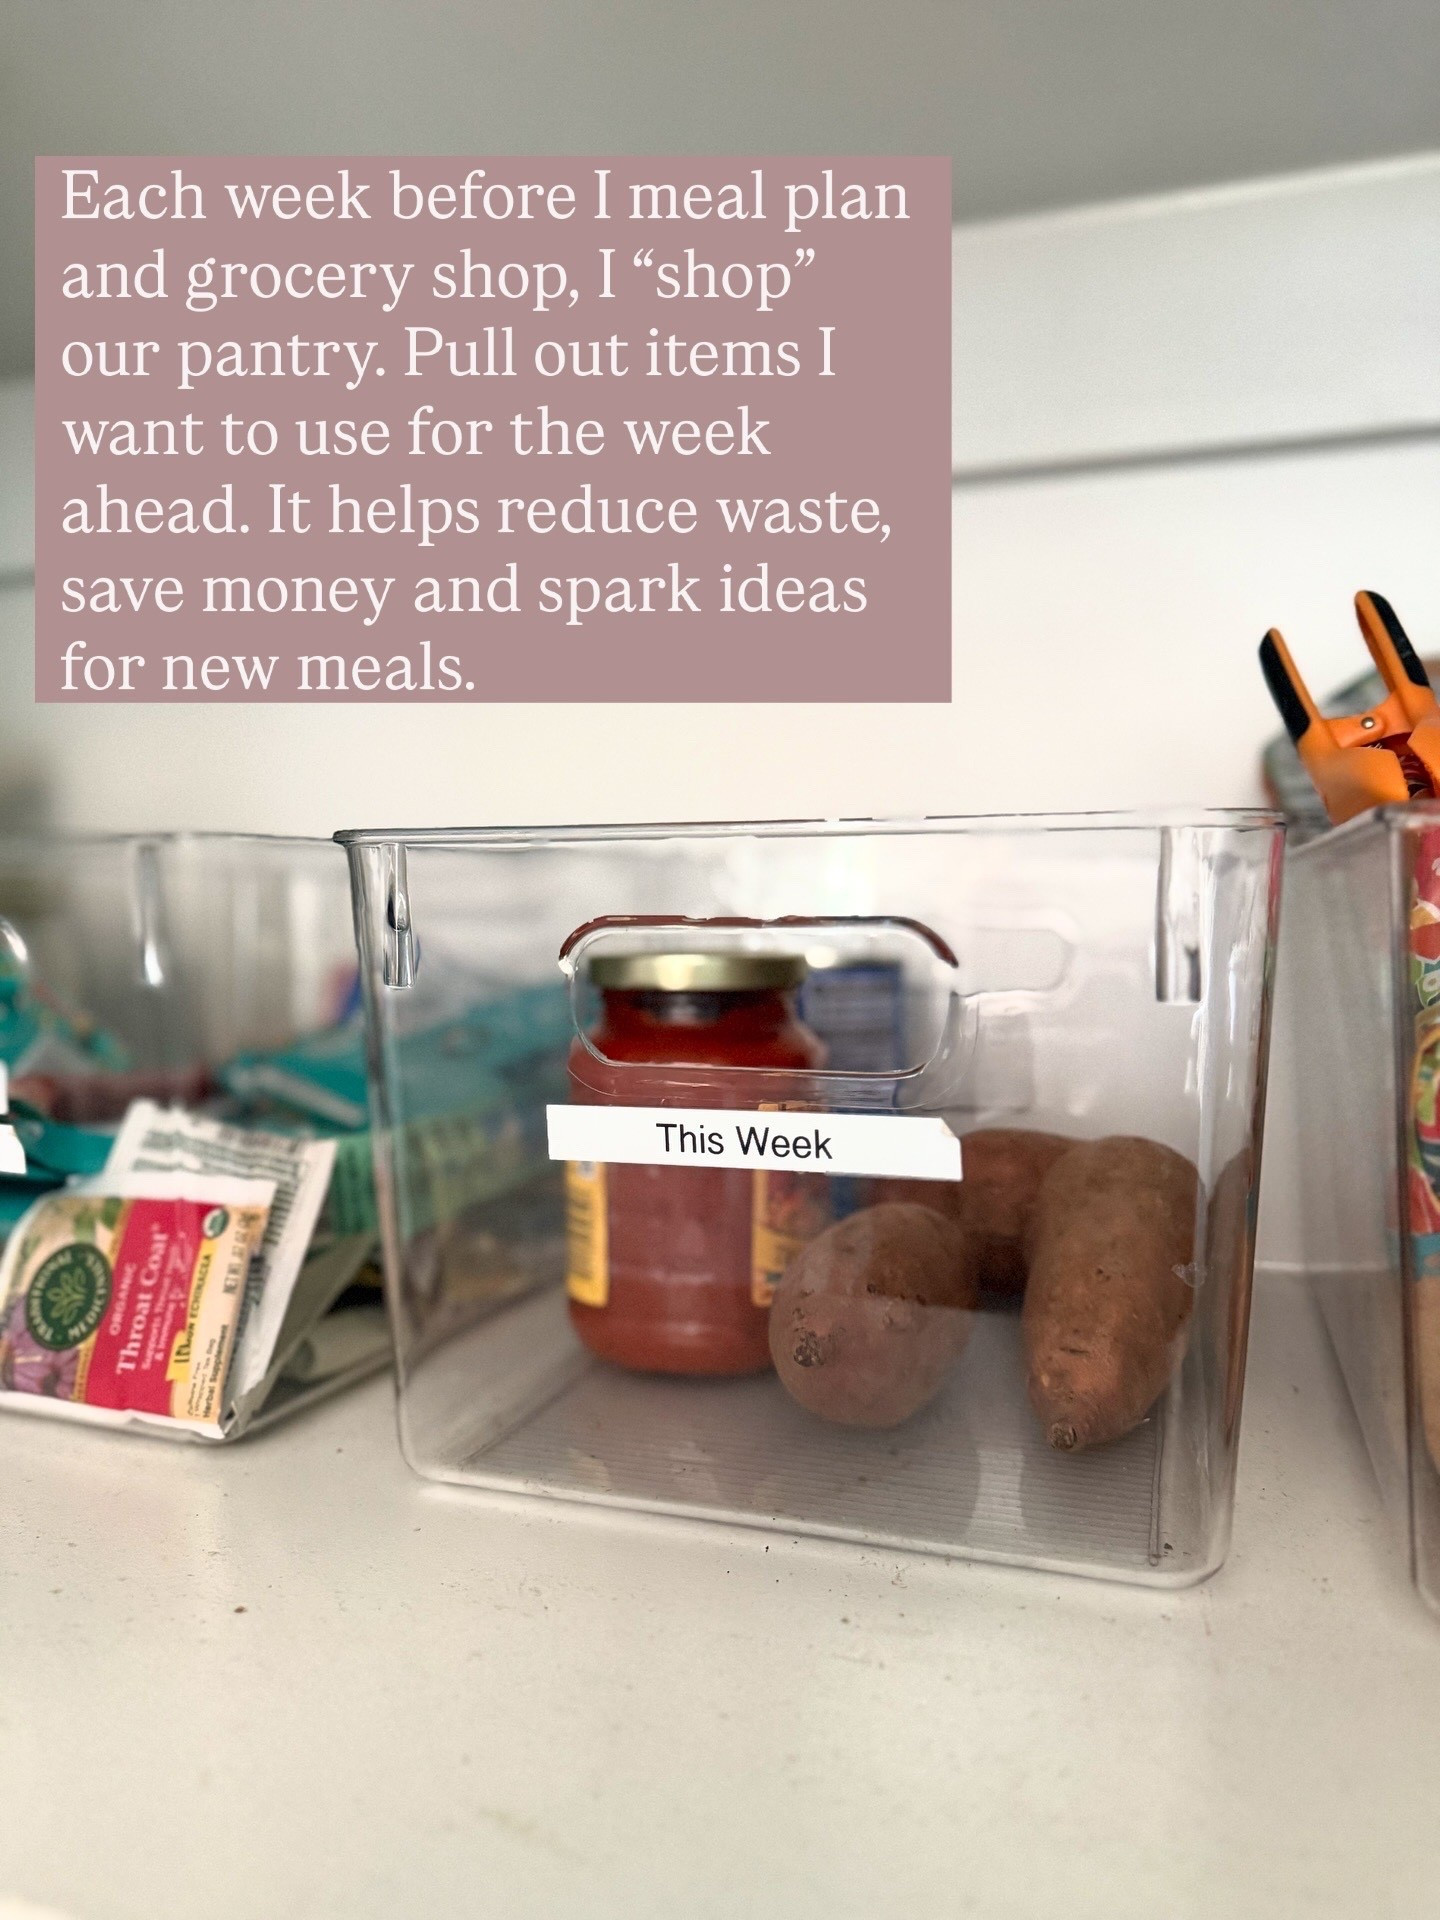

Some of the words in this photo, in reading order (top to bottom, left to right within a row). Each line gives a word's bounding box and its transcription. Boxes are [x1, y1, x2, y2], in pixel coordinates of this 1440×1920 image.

[655, 1123, 725, 1155] This
[735, 1126, 833, 1160] Week
[107, 1262, 137, 1336] ORGANIC
[189, 1255, 212, 1318] ECHINACEA
[115, 1293, 155, 1374] Throat
[208, 1324, 229, 1383] Supplement
[202, 1386, 216, 1418] Herbal
